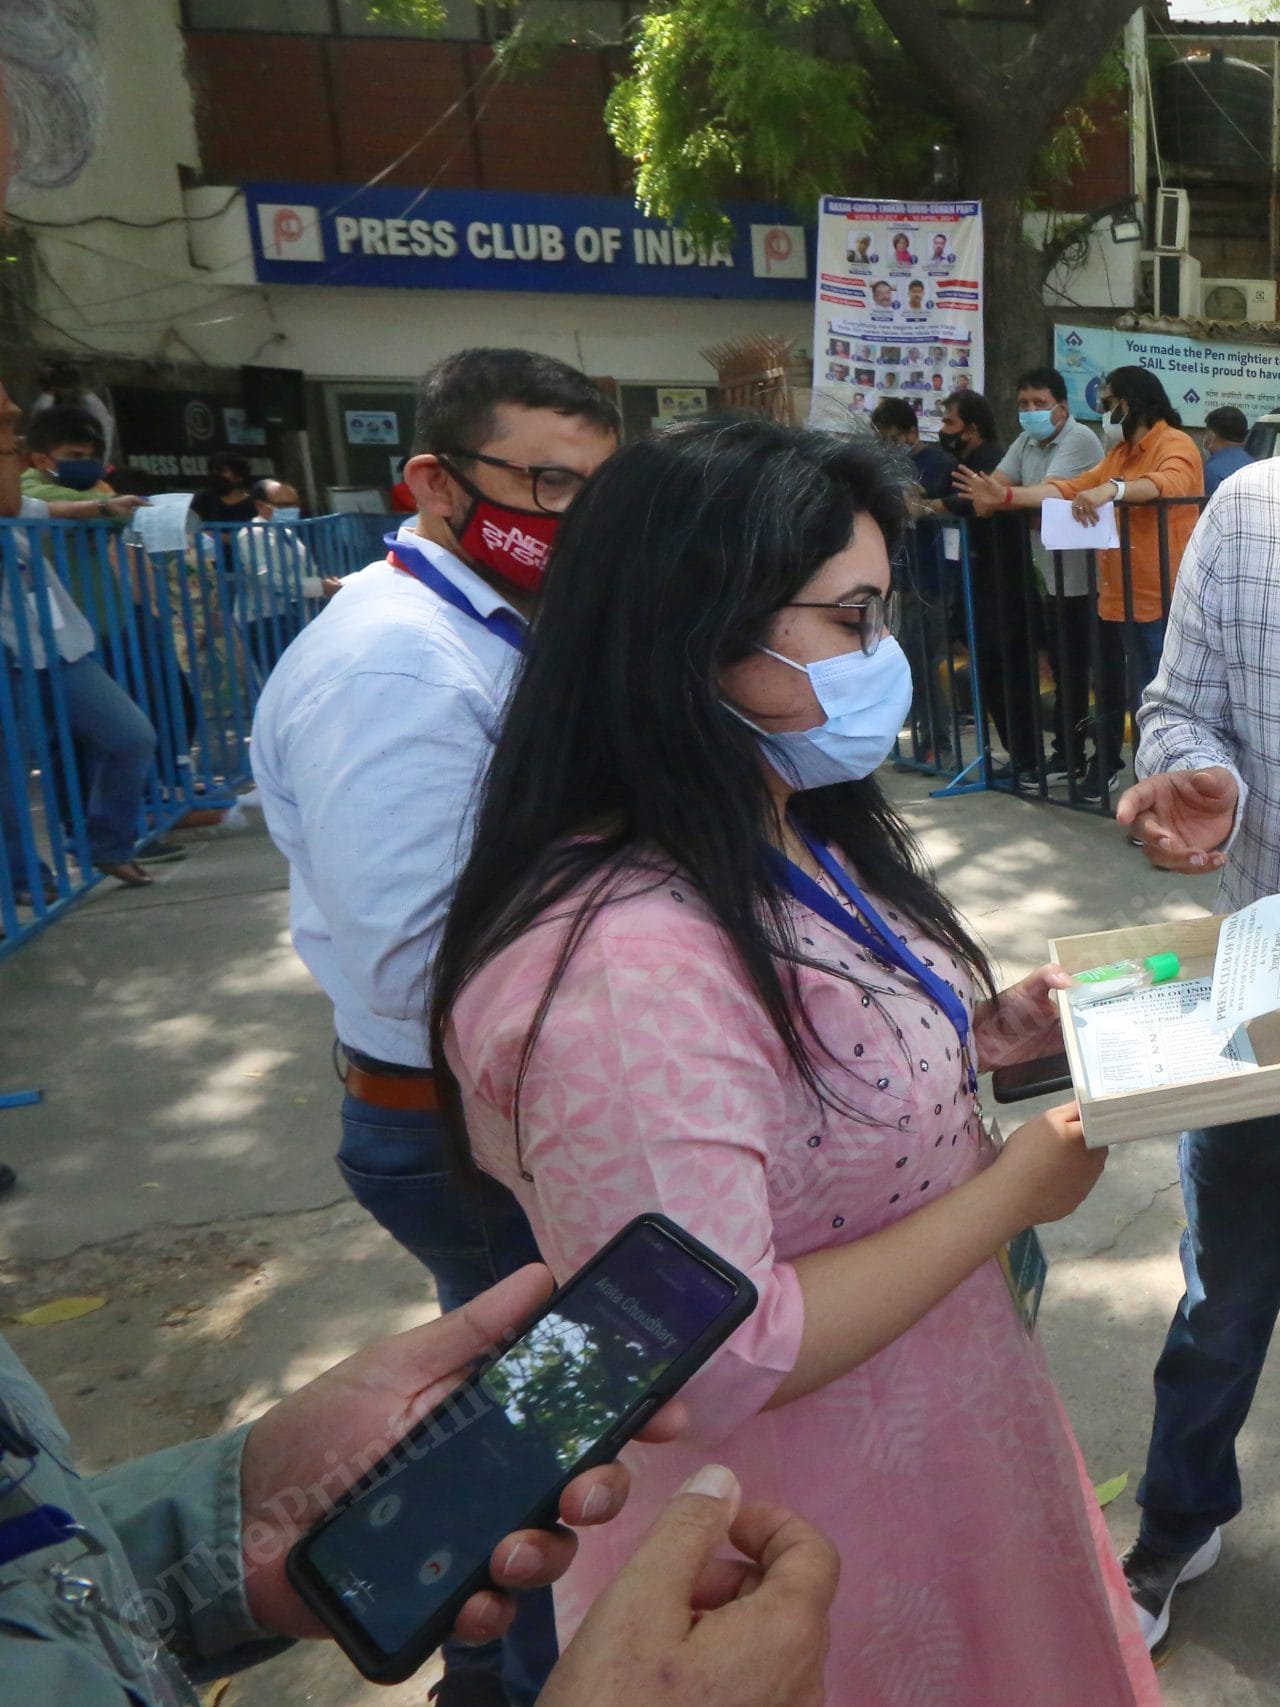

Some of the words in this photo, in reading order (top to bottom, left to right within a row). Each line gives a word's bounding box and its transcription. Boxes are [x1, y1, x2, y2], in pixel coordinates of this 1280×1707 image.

[336, 216, 458, 258] PRESS
[467, 222, 565, 264] CLUB
[575, 225, 624, 264] OF
[1126, 340, 1147, 353] You
[1150, 343, 1181, 356] made
[1183, 345, 1202, 358] the
[1204, 348, 1225, 360] Pen
[1227, 350, 1272, 367] mightier
[1139, 357, 1165, 370] SAIL
[1168, 361, 1198, 373] Steel
[1200, 362, 1209, 374] is
[1212, 364, 1243, 380] proud
[1246, 367, 1257, 378] to
[180, 456, 209, 476] CLU
[1226, 913, 1239, 941] INDIA
[1247, 907, 1257, 934] ENERGY
[1224, 942, 1234, 955] OF
[1241, 935, 1253, 973] YOUTHFUL
[1251, 924, 1263, 967] EXPERIENCE
[1260, 937, 1269, 958] UNITY
[1220, 956, 1232, 985] CLUB
[1269, 954, 1280, 972] Your
[1240, 974, 1246, 983] OF
[1187, 986, 1213, 996] INDI
[1238, 985, 1246, 1011] BLEND
[1216, 986, 1228, 1021] PRESS
[1148, 1033, 1158, 1043] 2
[1151, 1045, 1161, 1055] 2
[1154, 1064, 1164, 1074] 3
[622, 1297, 678, 1349] Choudhary
